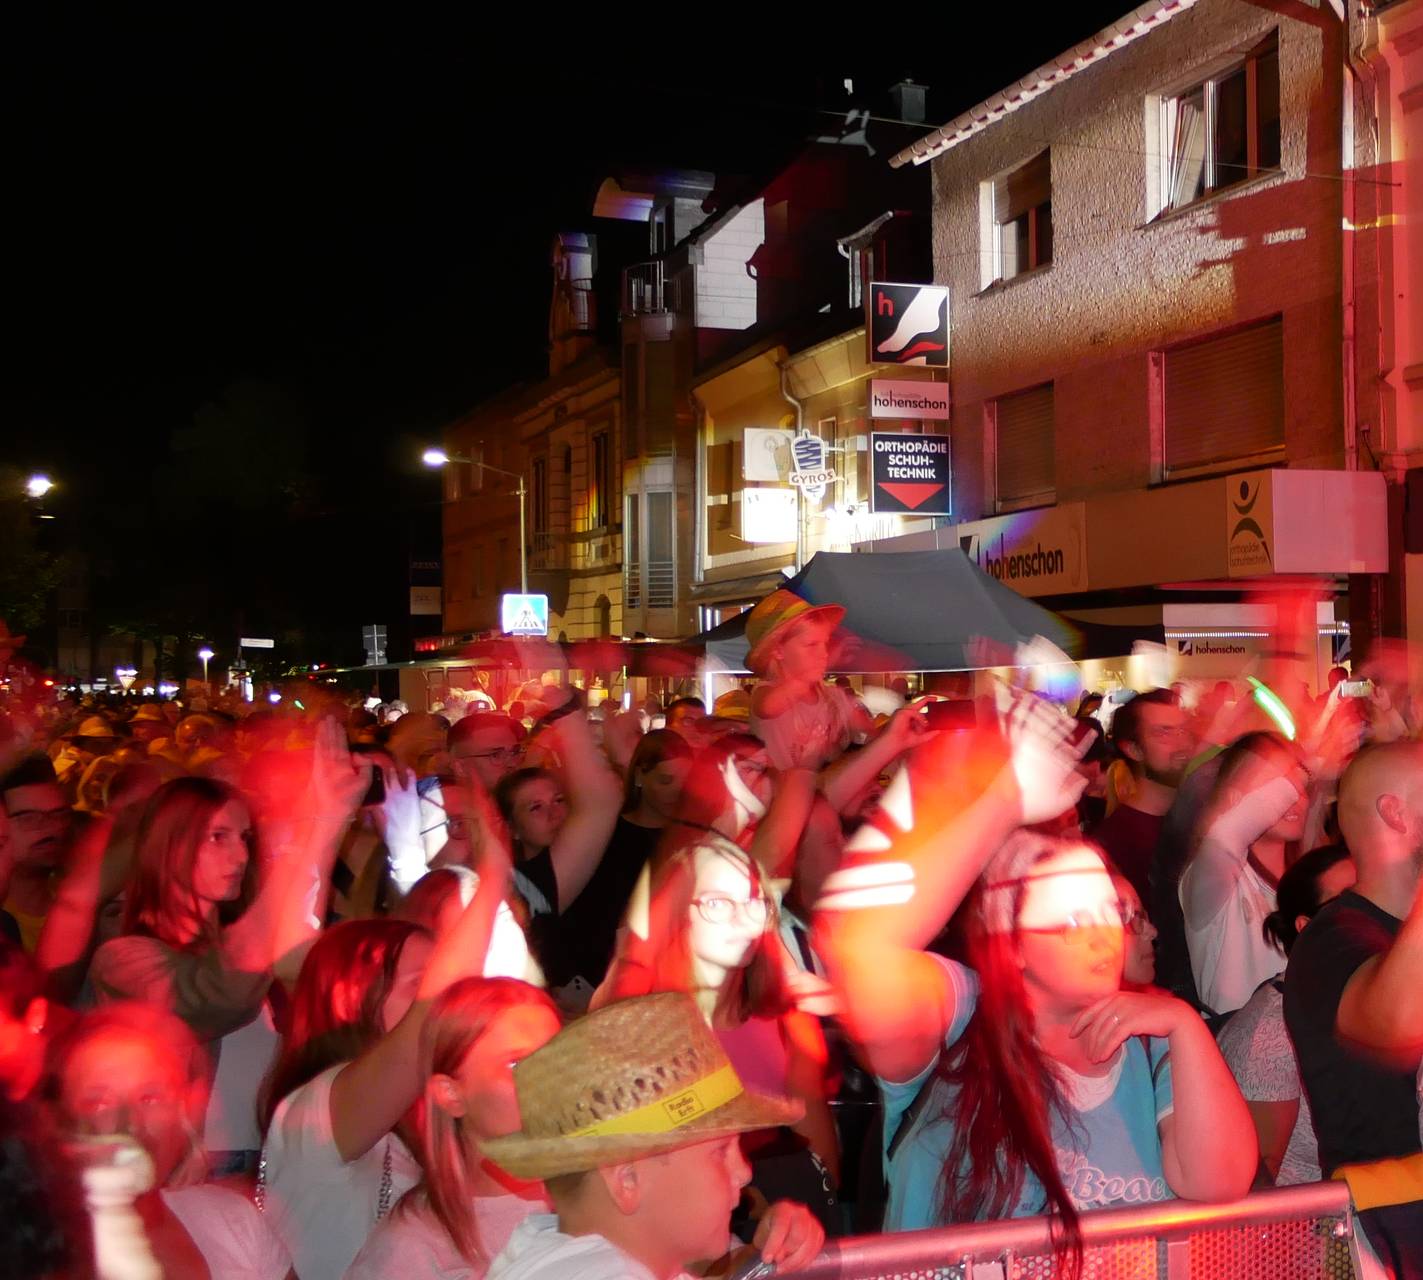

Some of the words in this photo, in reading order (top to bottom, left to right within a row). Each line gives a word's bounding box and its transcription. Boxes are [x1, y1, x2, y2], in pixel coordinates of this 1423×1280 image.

[877, 291, 894, 317] h
[874, 389, 947, 410] hohenschon
[875, 440, 947, 454] ORTHOPÄDIE
[888, 454, 935, 466] SCHUH-
[791, 470, 834, 484] GYROS
[887, 466, 937, 479] TECHNIK
[985, 532, 1064, 580] hohenschon
[1195, 641, 1246, 655] hohenschon
[669, 1096, 695, 1111] Radio
[1072, 1166, 1178, 1202] Beac
